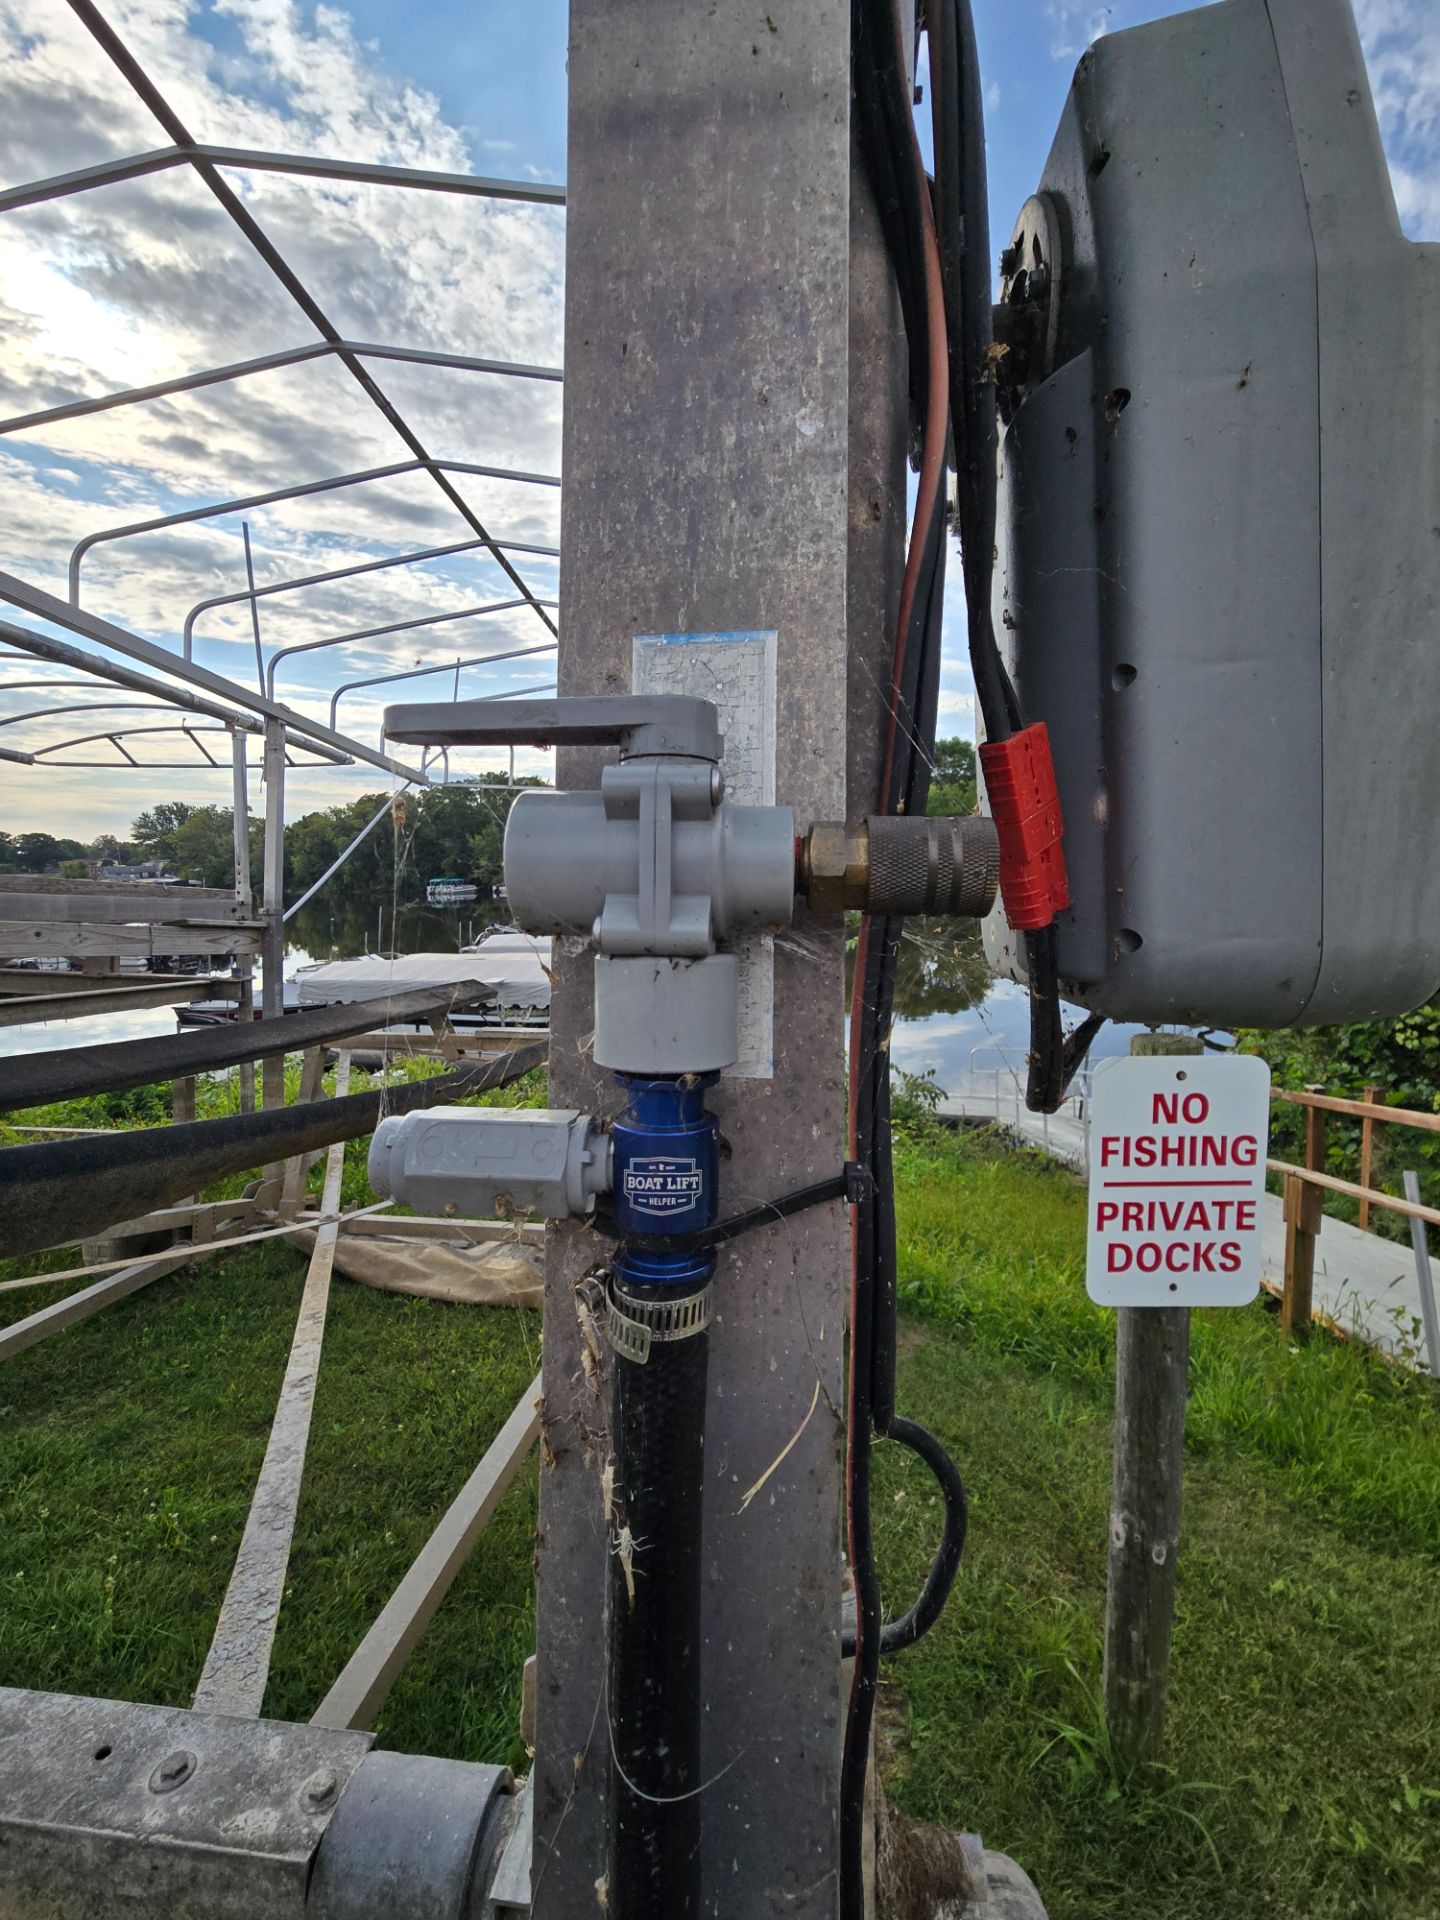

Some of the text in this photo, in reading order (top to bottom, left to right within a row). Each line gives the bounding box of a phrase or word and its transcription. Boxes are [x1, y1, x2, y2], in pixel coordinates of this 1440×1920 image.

[1152, 1092, 1210, 1124] NO
[1100, 1135, 1258, 1168] FISHING
[627, 1176, 699, 1190] BOAT LIFT
[649, 1197, 676, 1206] HELPER
[1096, 1200, 1257, 1232] PRIVATE
[1107, 1241, 1242, 1273] DOCKS
